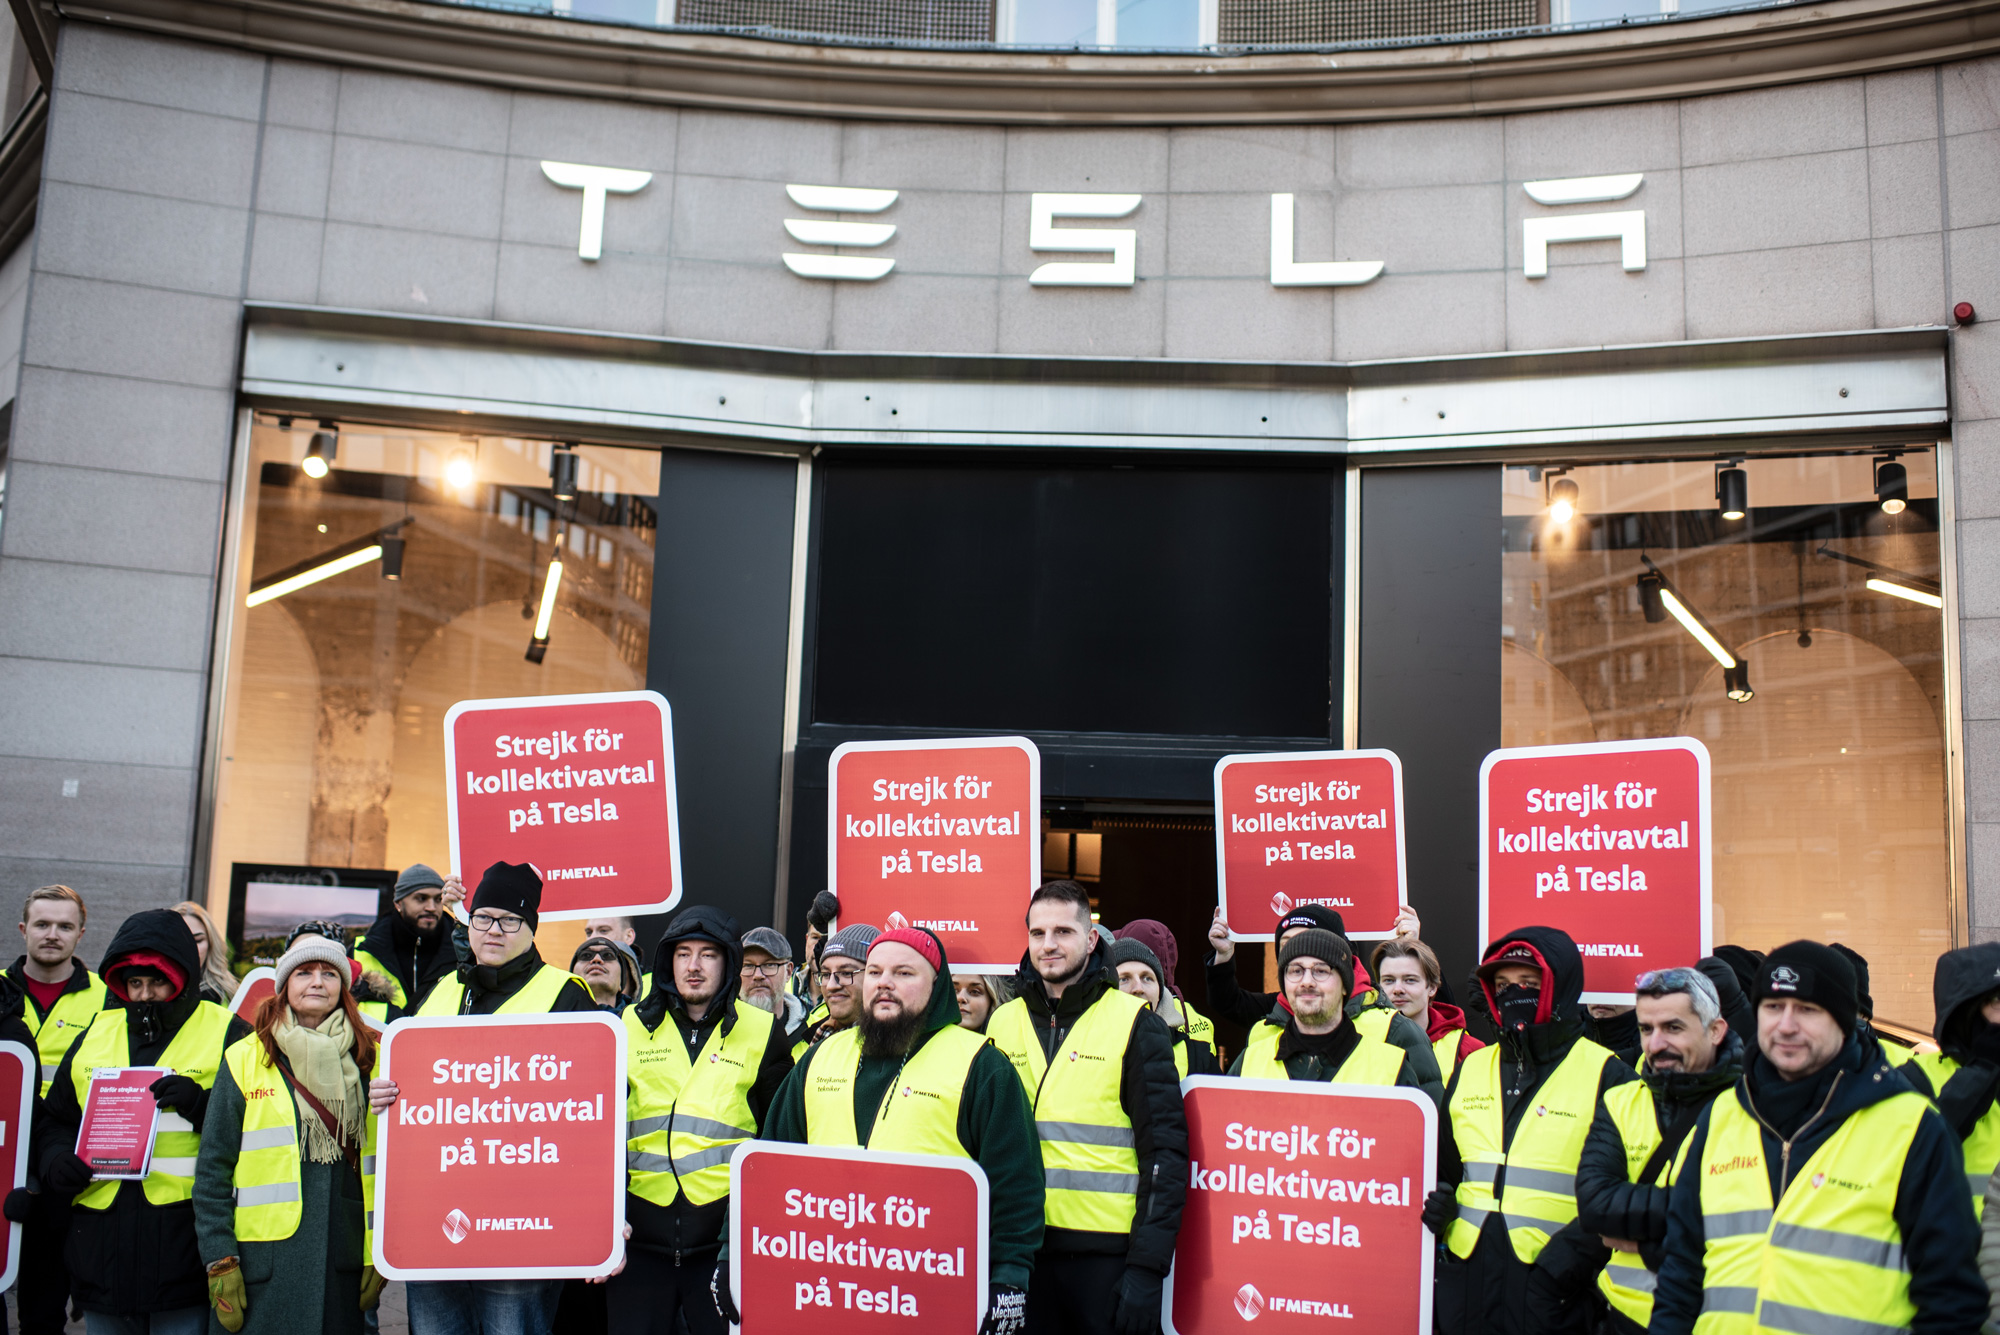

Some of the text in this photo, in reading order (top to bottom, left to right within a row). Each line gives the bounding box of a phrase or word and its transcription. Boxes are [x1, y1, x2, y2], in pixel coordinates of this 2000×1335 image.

[540, 159, 1648, 288] TESLA
[494, 727, 623, 760] Strejk för
[466, 759, 655, 795] kollektivavtal
[872, 774, 992, 807] Strejk för
[1254, 780, 1361, 807] Strejk för
[508, 797, 619, 833] på Tesla
[1526, 781, 1658, 818] Strejk för
[845, 810, 1020, 838] kollektivavtal
[1231, 808, 1387, 834] kollektivavtal
[1498, 820, 1689, 854] kollektivavtal
[881, 848, 983, 879] på Tesla
[1265, 839, 1356, 866] på Tesla
[1535, 863, 1648, 899] på Tesla
[636, 1047, 672, 1058] Strejkande
[639, 1056, 667, 1064] tekniker
[432, 1053, 573, 1090] Strejk för
[816, 1076, 848, 1085] Strejkande
[817, 1085, 841, 1093] tekniker
[398, 1093, 604, 1126] kollektivavtal
[439, 1135, 560, 1173] på Tesla
[1225, 1121, 1377, 1162] Strejk för
[1709, 1156, 1759, 1176] Konflikt
[1190, 1161, 1411, 1207] kollektivavtal
[784, 1188, 931, 1230] Strejk för
[1231, 1209, 1362, 1249] på Tesla
[752, 1226, 965, 1277] kollektivavtal
[795, 1277, 919, 1317] på Tesla
